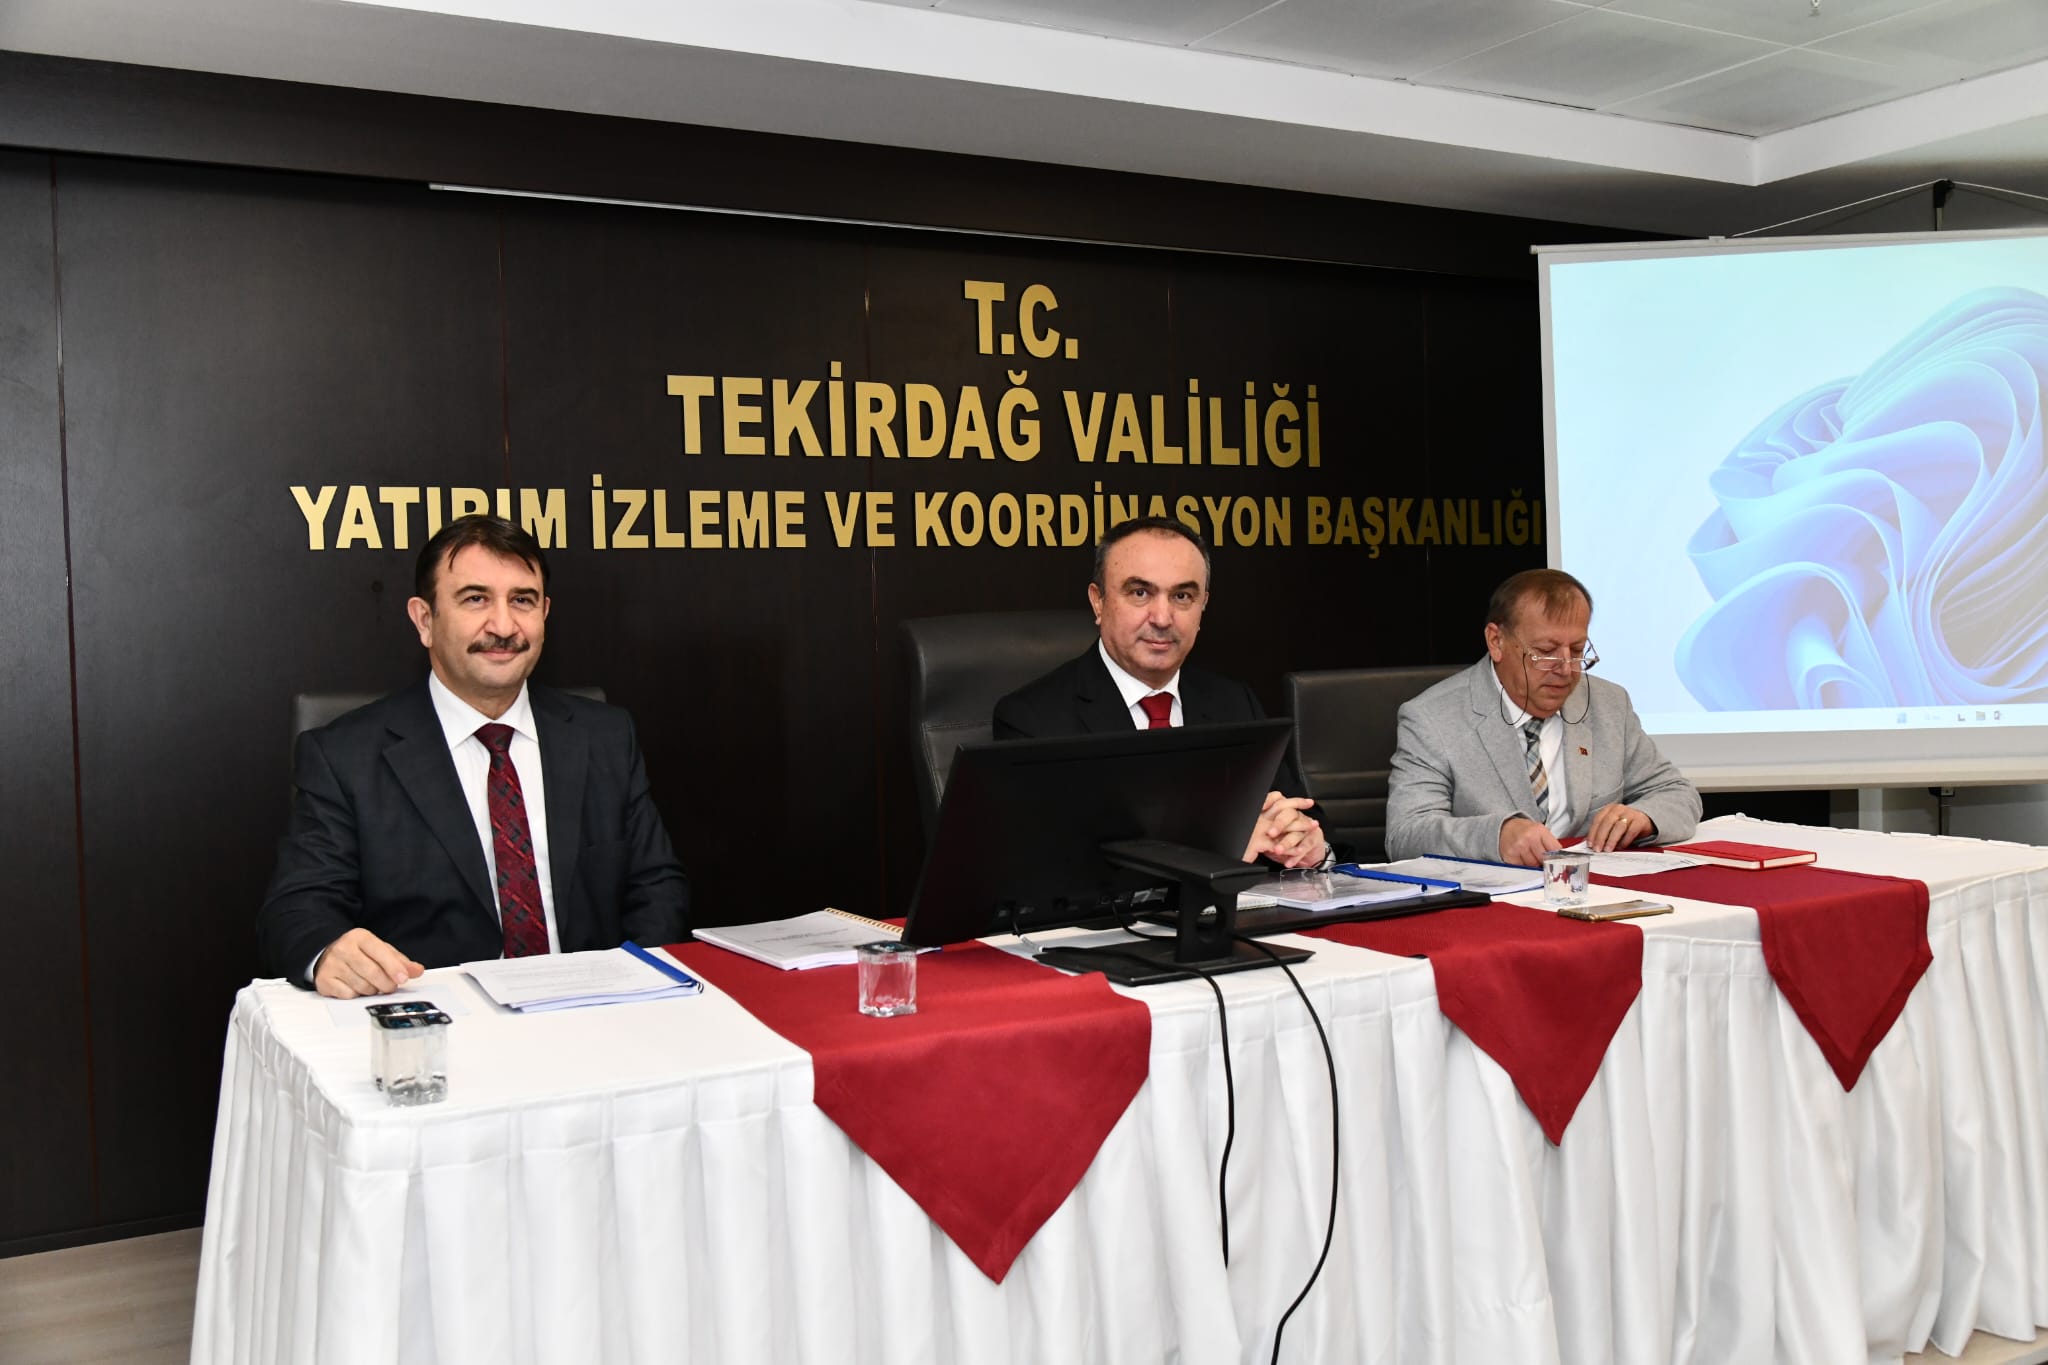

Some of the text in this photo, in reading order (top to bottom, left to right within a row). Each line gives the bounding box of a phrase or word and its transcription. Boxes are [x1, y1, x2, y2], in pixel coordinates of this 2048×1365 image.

[963, 280, 1079, 360] T.C.
[667, 360, 1321, 468] TEKİRDAĞ VALİLİĞİ
[592, 472, 808, 550] İZLEME
[824, 490, 897, 549] VE
[1307, 488, 1542, 559] BAŞKANLIĞI
